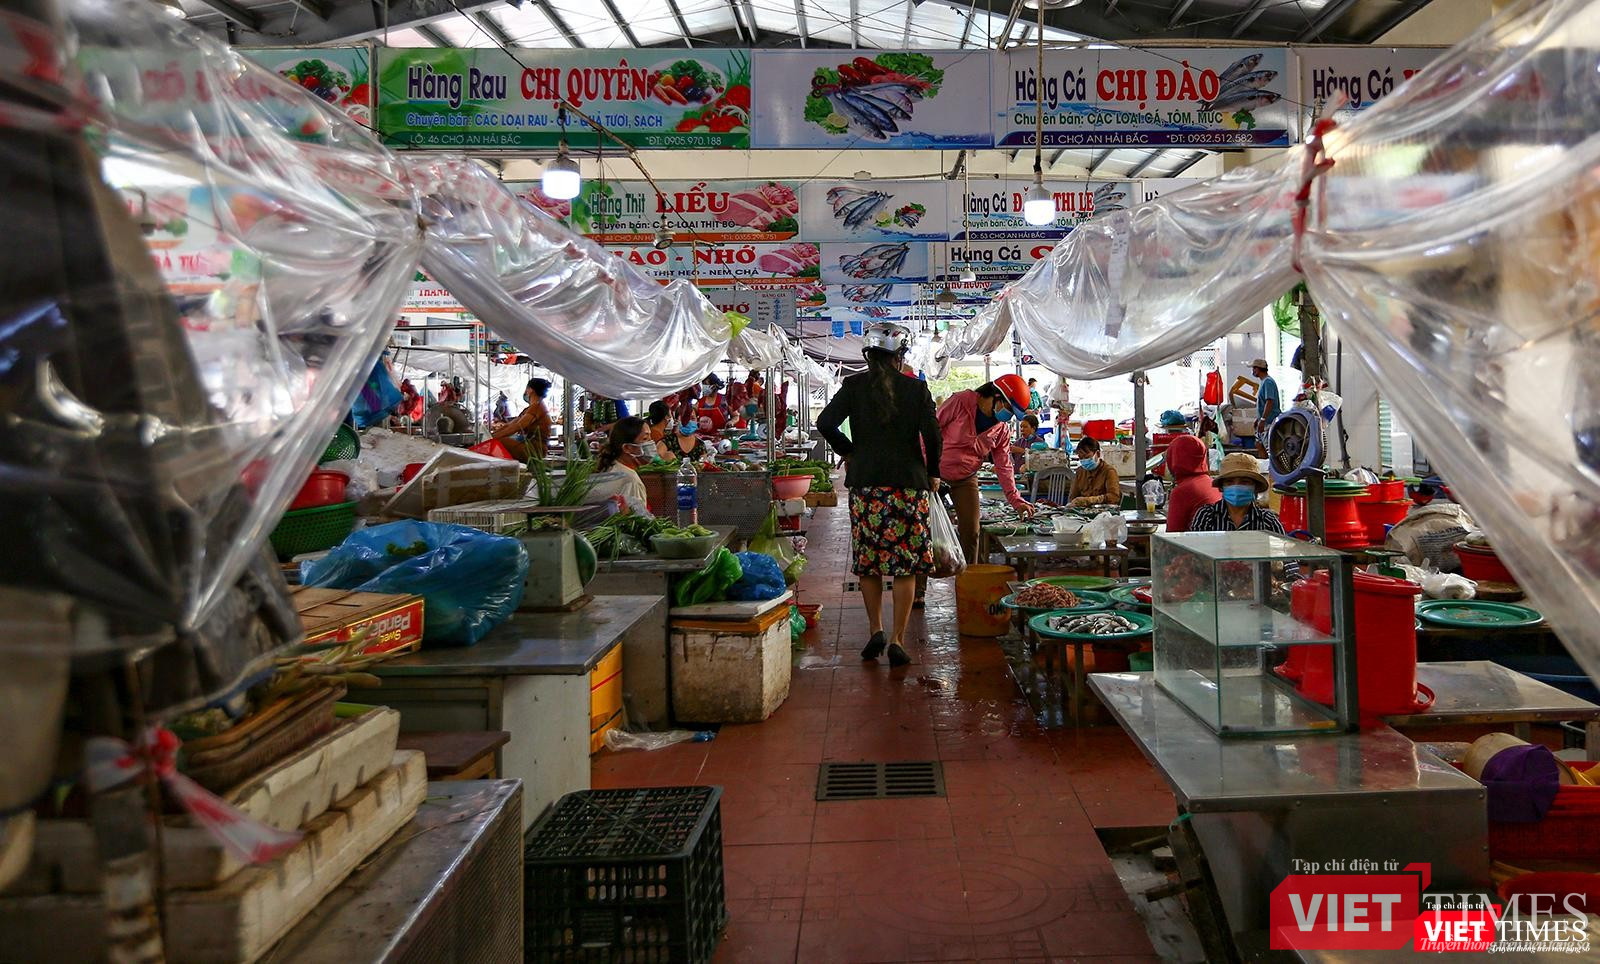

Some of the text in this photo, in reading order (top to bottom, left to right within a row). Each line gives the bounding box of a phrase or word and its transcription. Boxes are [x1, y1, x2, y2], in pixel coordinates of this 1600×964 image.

[408, 58, 648, 109] Hàng Rau CHỊ QUYÊN
[1015, 60, 1220, 110] Hàng Cá CHỊ ĐÀO
[1312, 67, 1394, 108] Hàng Cá
[406, 113, 446, 129] Chuyên
[448, 112, 472, 127] bán:
[475, 112, 498, 126] CÁC
[501, 114, 525, 129] LOẠI
[528, 114, 548, 126] RAU
[605, 114, 631, 129] TƯƠI,
[635, 115, 663, 130] SẠCH
[1014, 112, 1056, 126] Chuên
[1060, 112, 1084, 125] bán:
[1167, 109, 1195, 125] TÔM,
[428, 134, 439, 144] 46
[441, 134, 465, 144] CHỢ
[467, 135, 481, 144] AN
[482, 132, 499, 144] HẢI
[501, 132, 521, 145] BẮC
[664, 136, 722, 146] 0905.970.188
[1043, 134, 1055, 144] 51
[1058, 134, 1084, 144] CHỢ
[1086, 134, 1102, 144] AN
[1104, 132, 1123, 144] HẢI
[1125, 132, 1148, 144] BẮC
[1188, 133, 1253, 144] 0932.512.582
[590, 182, 730, 219] Hàng Thịt LIỂU
[963, 191, 990, 218] Hàng
[992, 191, 1007, 213] Cá
[629, 220, 650, 229] bán:
[652, 221, 675, 229] CC
[968, 231, 979, 240] Ô:
[1006, 232, 1018, 240] AN
[998, 244, 1022, 261] Cá
